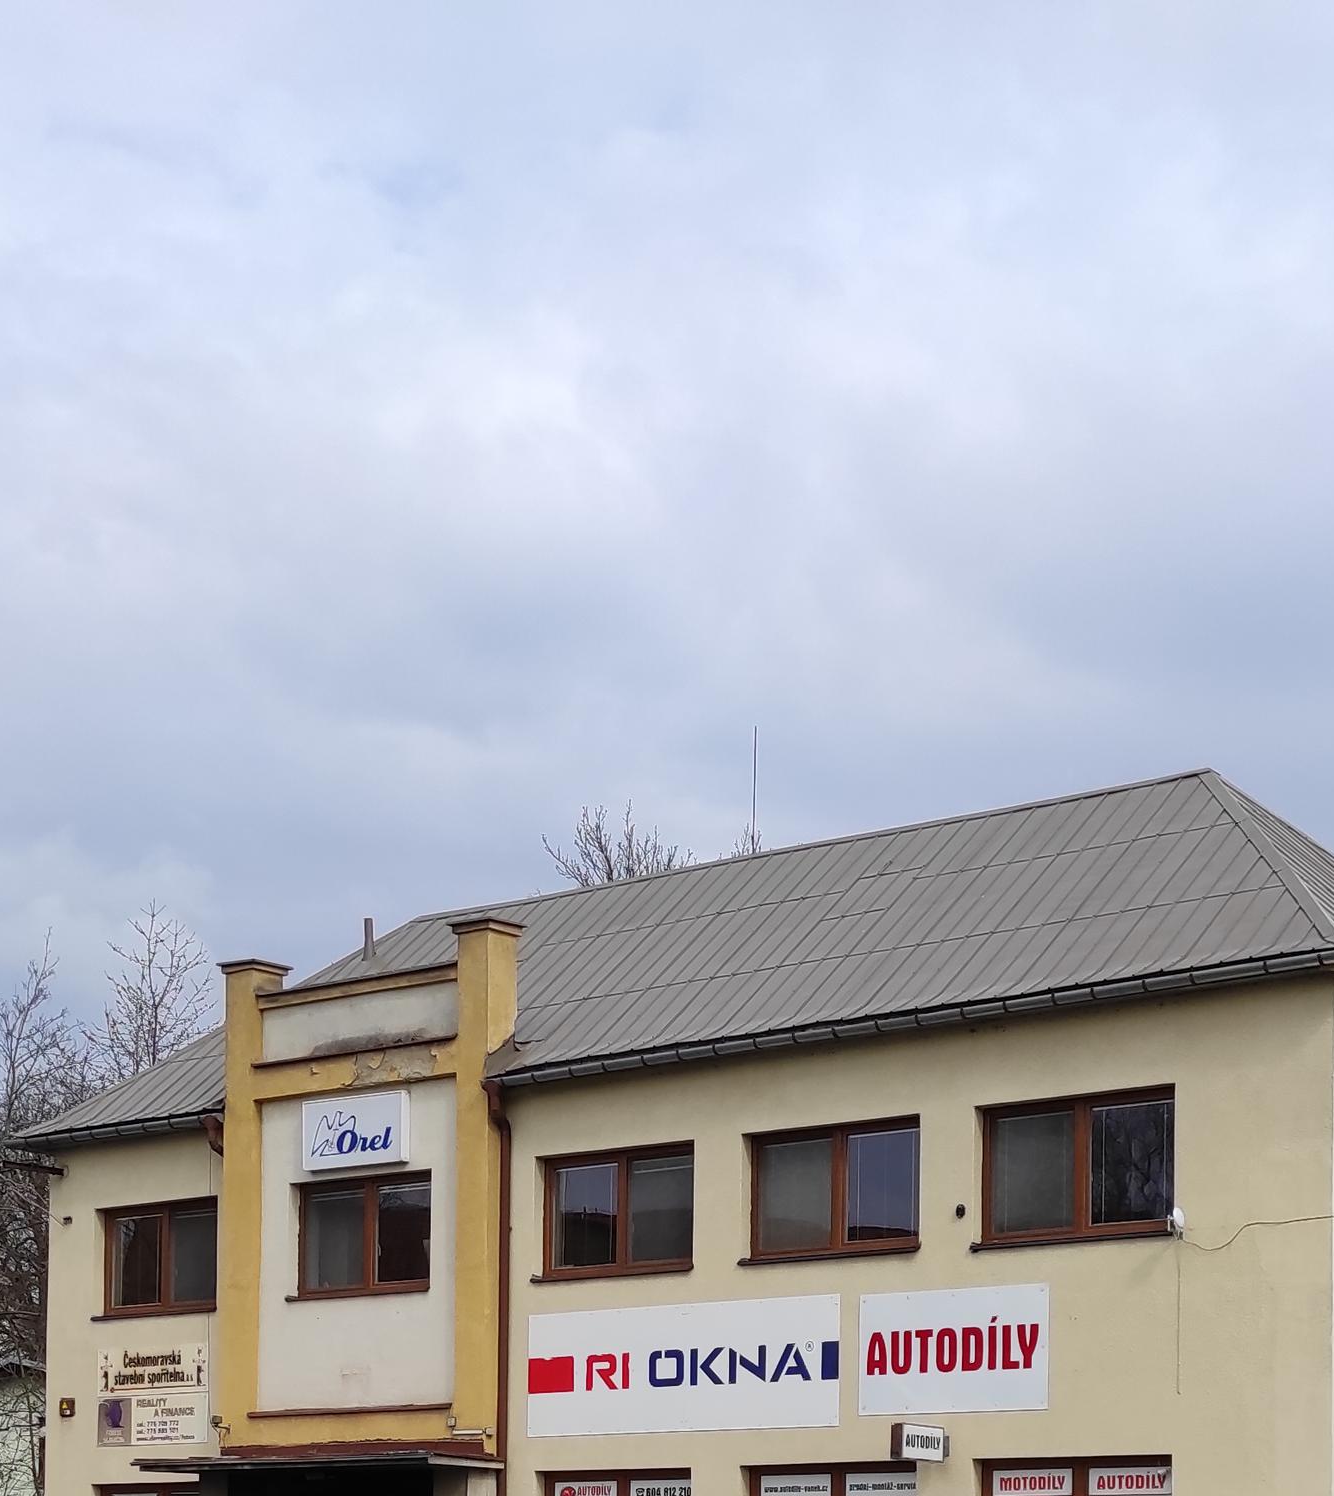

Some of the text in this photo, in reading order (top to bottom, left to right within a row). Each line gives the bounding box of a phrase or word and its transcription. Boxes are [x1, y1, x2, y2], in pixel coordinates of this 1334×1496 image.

[336, 1126, 393, 1154] Orel
[866, 1315, 1040, 1376] AUTODÍLY
[123, 1350, 182, 1368] Českomoravská
[585, 1342, 812, 1392] RI OKNA
[114, 1369, 146, 1386] stavební
[136, 1398, 168, 1408] REALITY
[161, 1406, 196, 1417] FINANCE
[905, 1432, 941, 1450] AUTODÍLY
[576, 1483, 612, 1496] AUTODÍLY
[999, 1473, 1066, 1492] MOTODÍLY
[1096, 1471, 1167, 1490] AUTODÍLY
